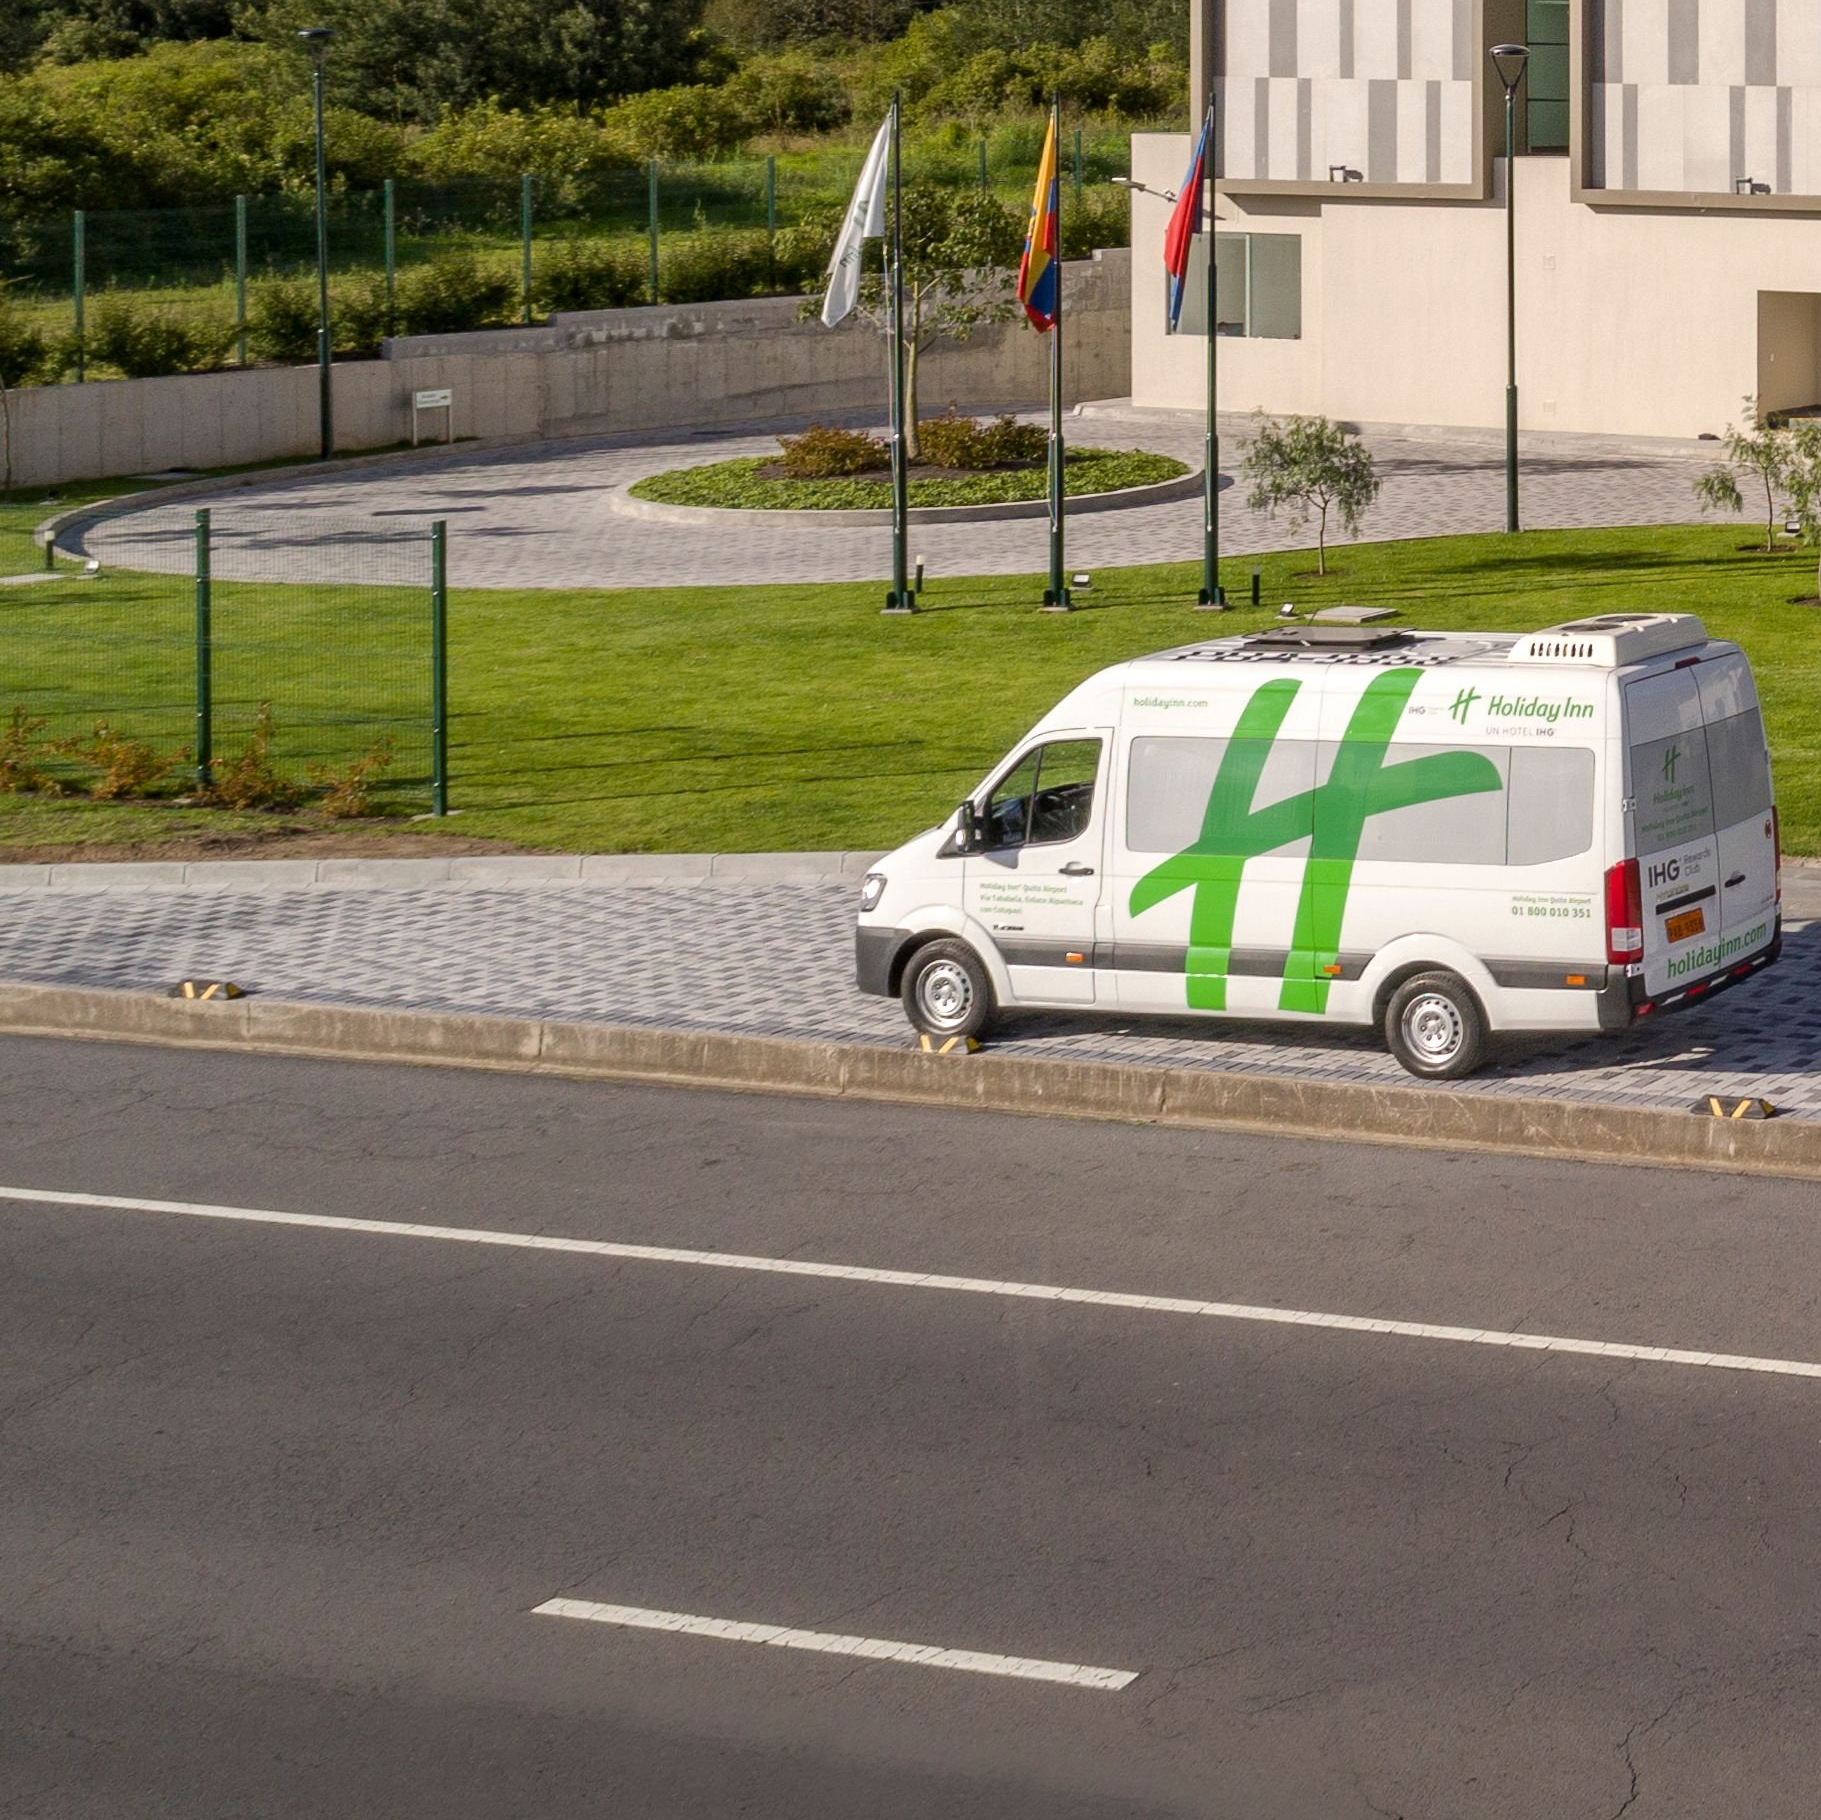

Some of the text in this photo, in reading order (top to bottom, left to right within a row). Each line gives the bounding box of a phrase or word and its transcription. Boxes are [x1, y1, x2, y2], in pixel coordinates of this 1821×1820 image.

[1133, 697, 1208, 709] holidayinn.com
[1488, 694, 1594, 723] Holiday Inn
[1408, 706, 1426, 715] IHG
[1486, 727, 1499, 736] UN
[1502, 727, 1532, 737] HOTEL
[1648, 859, 1680, 888] IHG
[1512, 906, 1591, 918] 01 800 010 351
[1668, 922, 1767, 978] holidayinn.com
